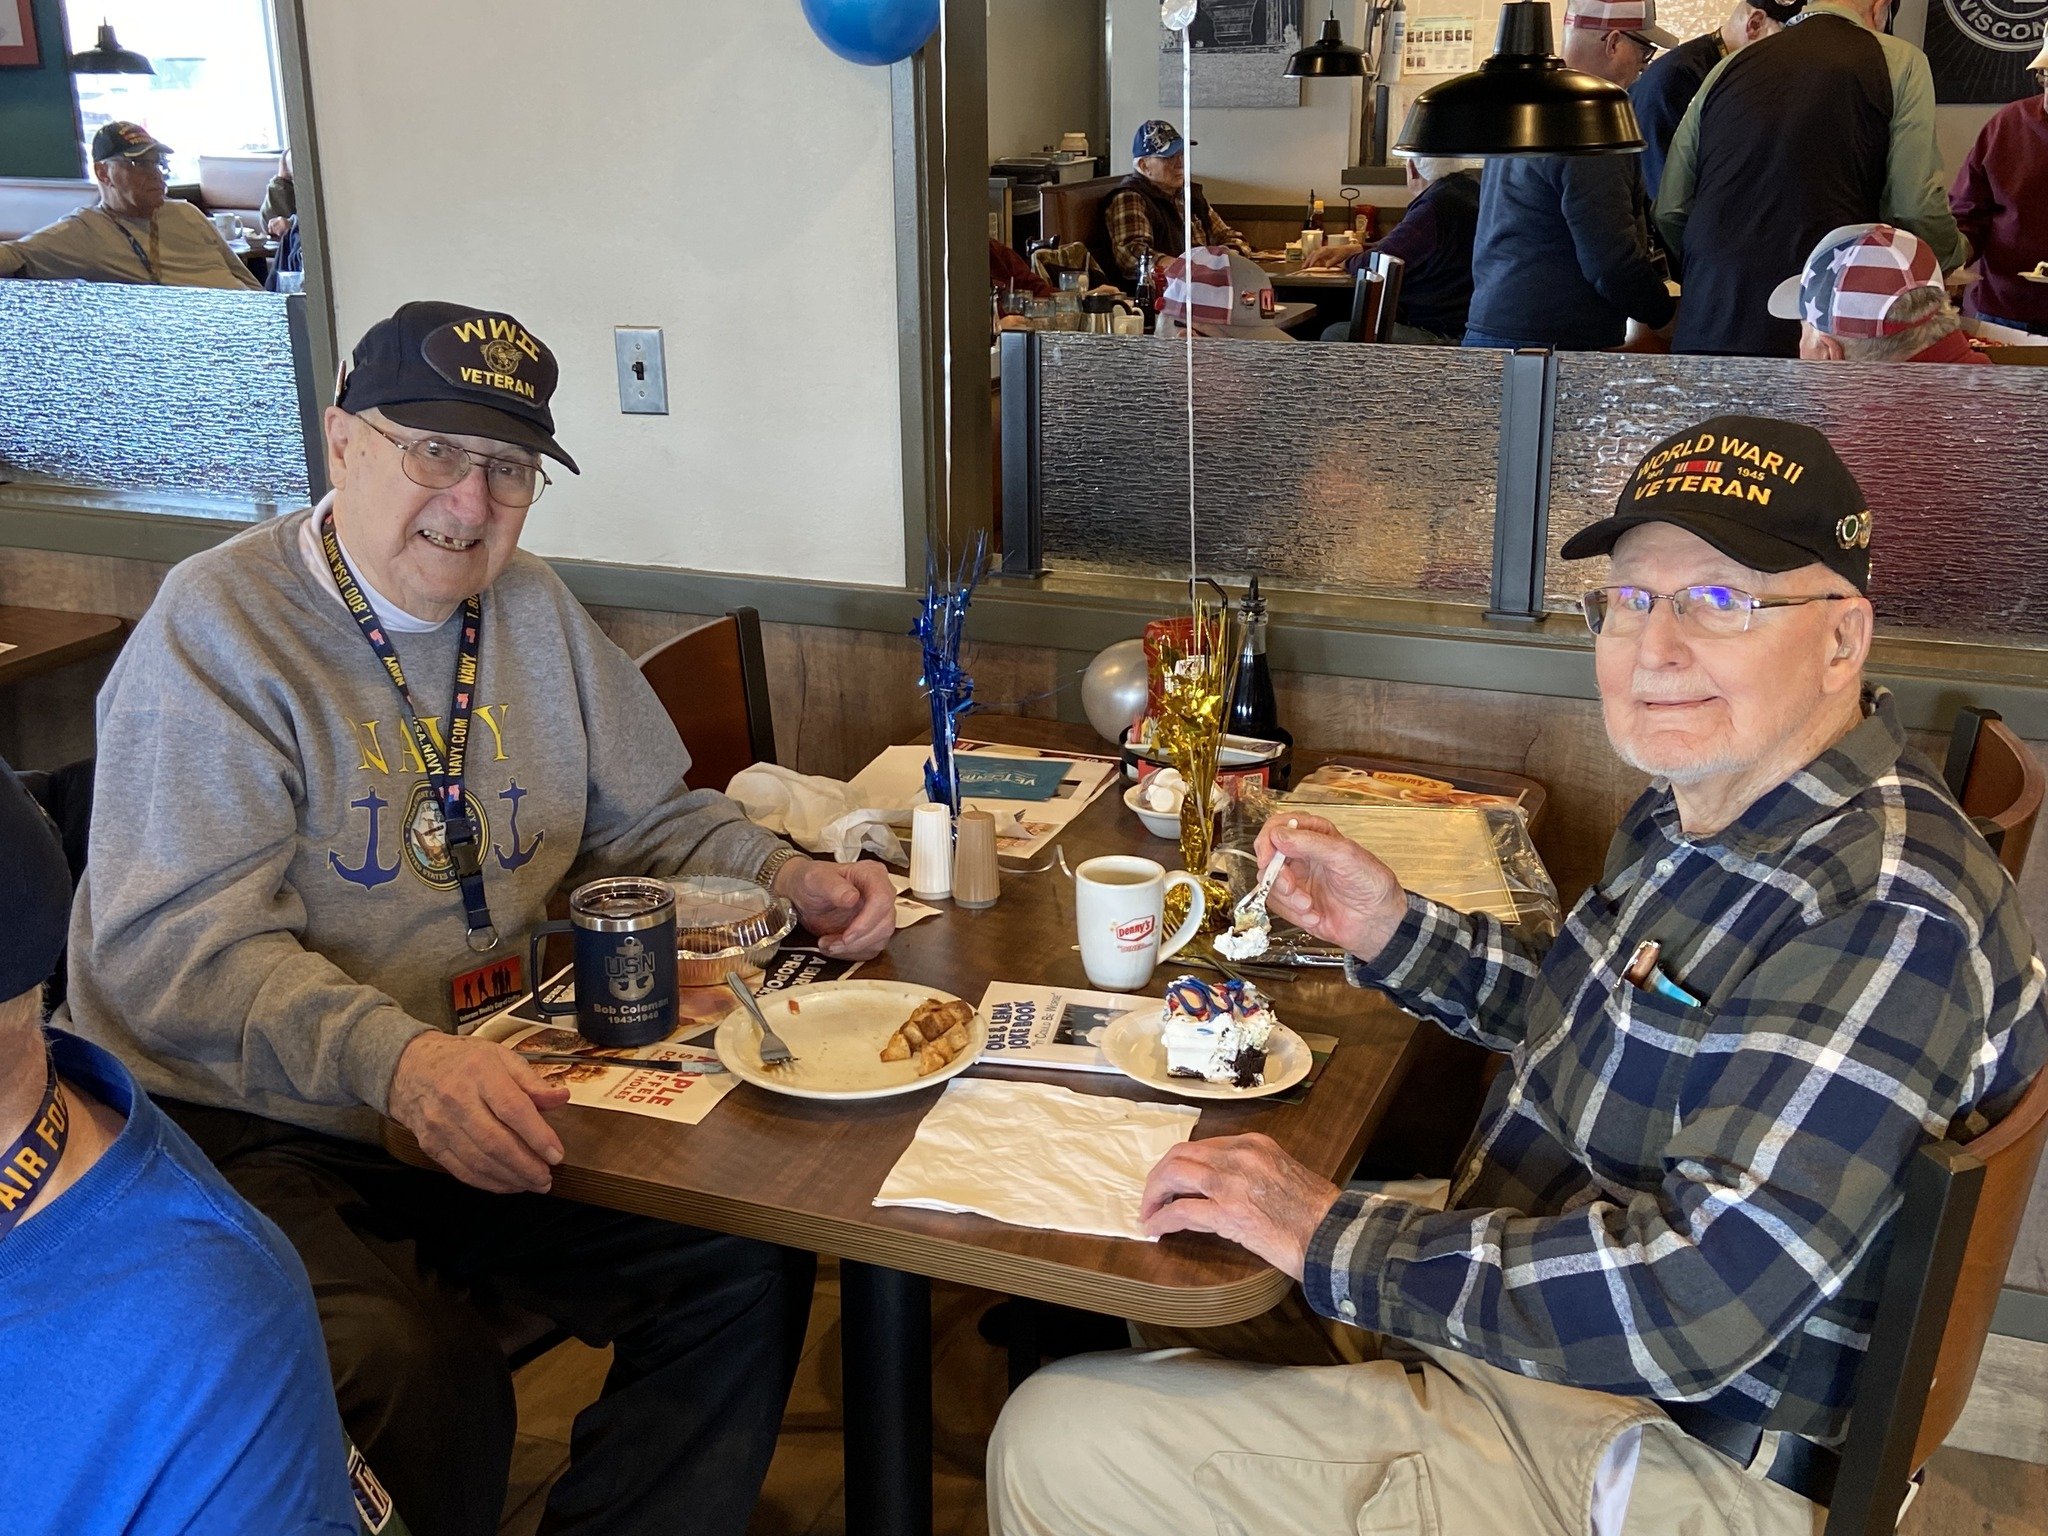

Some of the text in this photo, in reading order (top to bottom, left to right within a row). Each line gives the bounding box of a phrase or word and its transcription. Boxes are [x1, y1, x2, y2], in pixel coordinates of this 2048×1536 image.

[460, 366, 535, 399] VETERAN
[1635, 433, 1804, 485] WORLD WAR II
[1736, 466, 1766, 482] 1945
[1633, 475, 1772, 506] VETERAN
[382, 655, 406, 687] NAVY
[457, 652, 477, 686] NAVY
[448, 718, 469, 777] NAVY.COM
[1376, 773, 1440, 790] Denny's
[1118, 920, 1152, 938] Denny's
[604, 952, 656, 979] USN
[989, 1002, 1013, 1025] LENA
[1007, 1000, 1036, 1050] JOKE BOOK
[985, 1033, 1007, 1050] OLE
[613, 1076, 648, 1101] HOLES
[0, 1085, 68, 1212] AIR FOR
